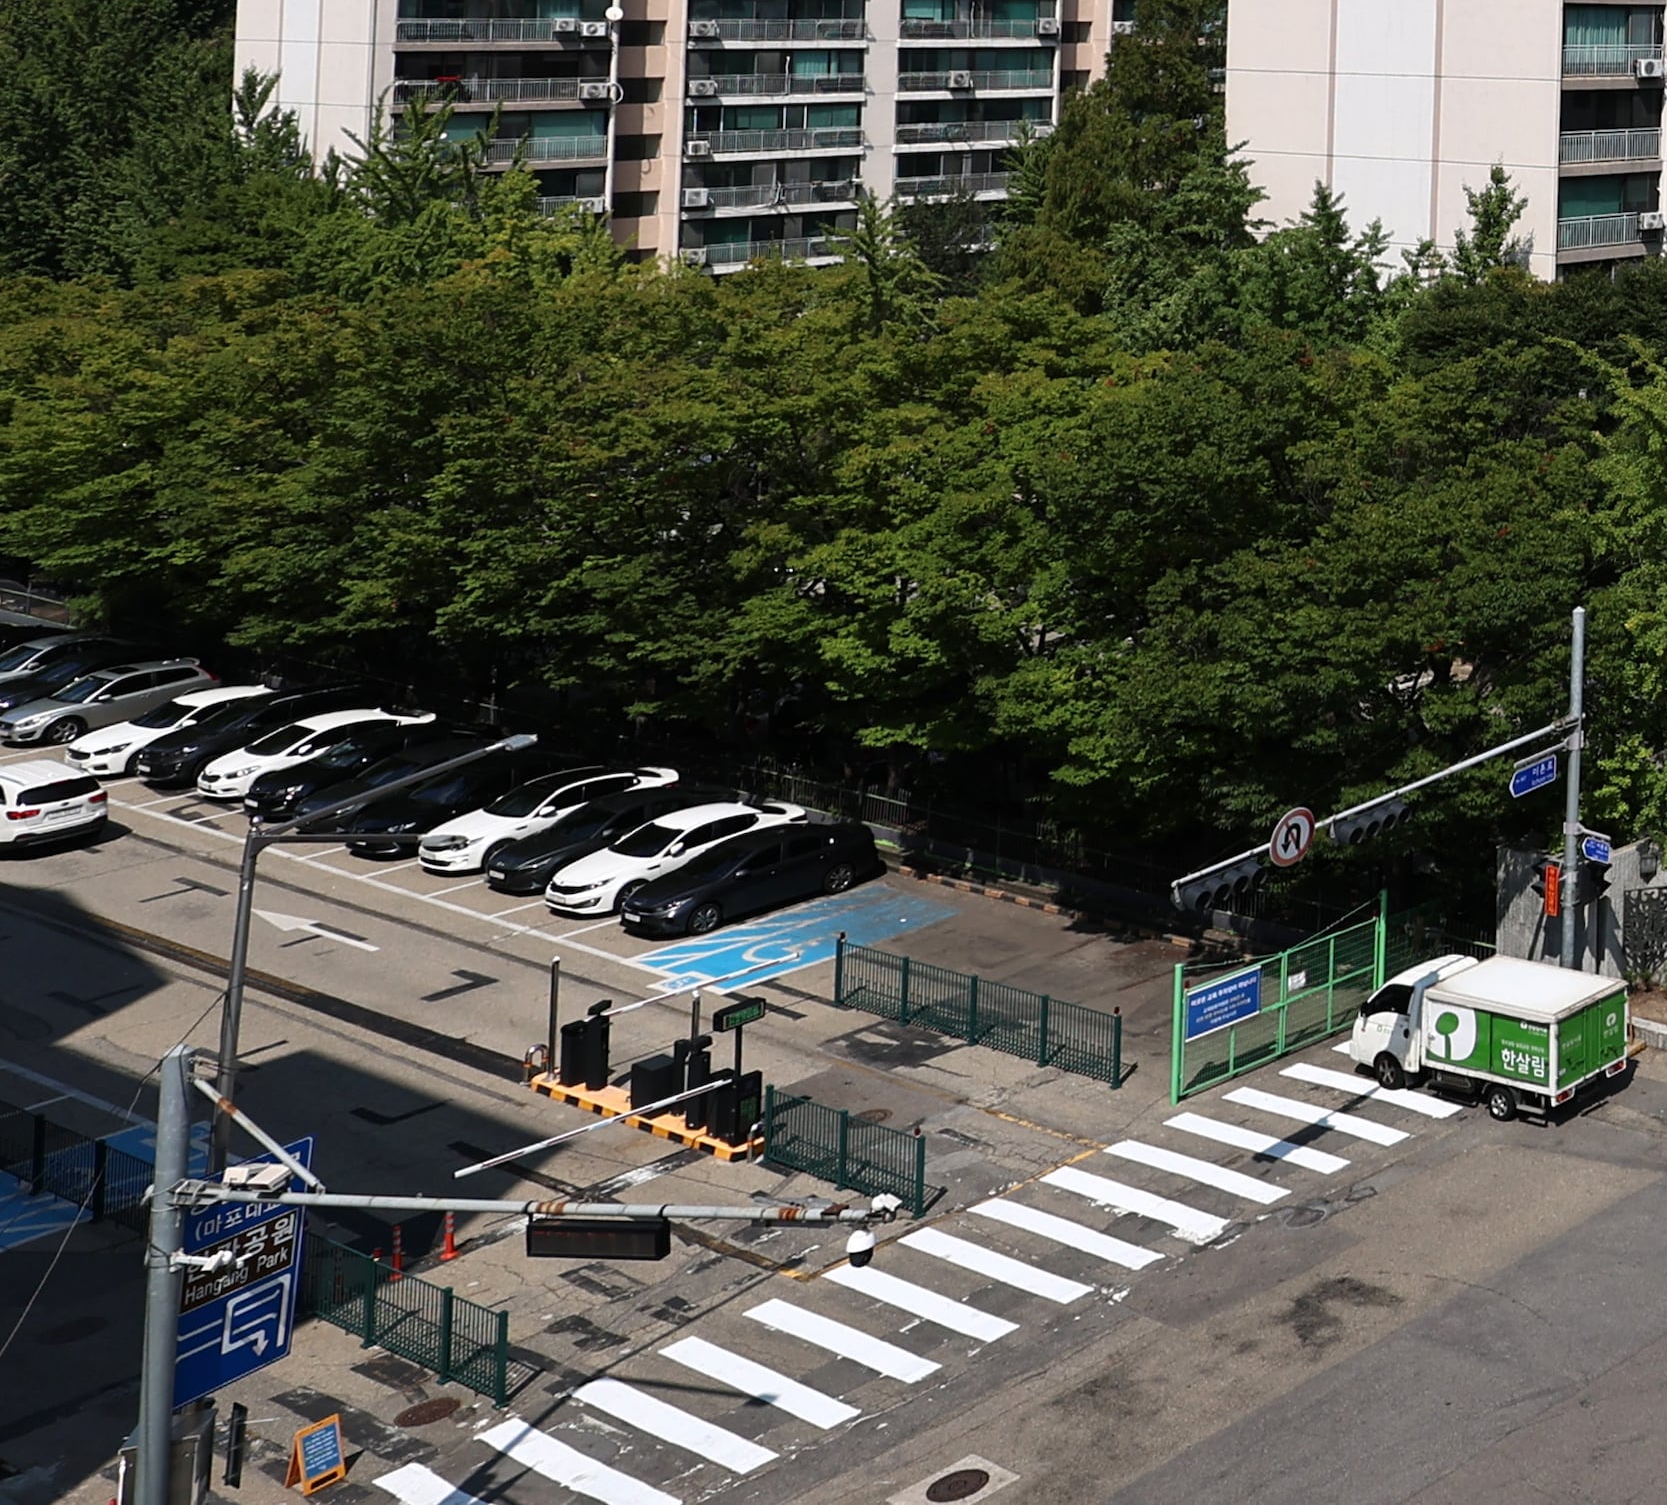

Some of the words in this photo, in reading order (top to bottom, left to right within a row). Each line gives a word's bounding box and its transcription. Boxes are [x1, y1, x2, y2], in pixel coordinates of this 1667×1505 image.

[1501, 1048, 1545, 1078] 한살림
[195, 1201, 281, 1241] (마포대
[184, 1265, 250, 1305] Hangang
[256, 1246, 289, 1273] Park
